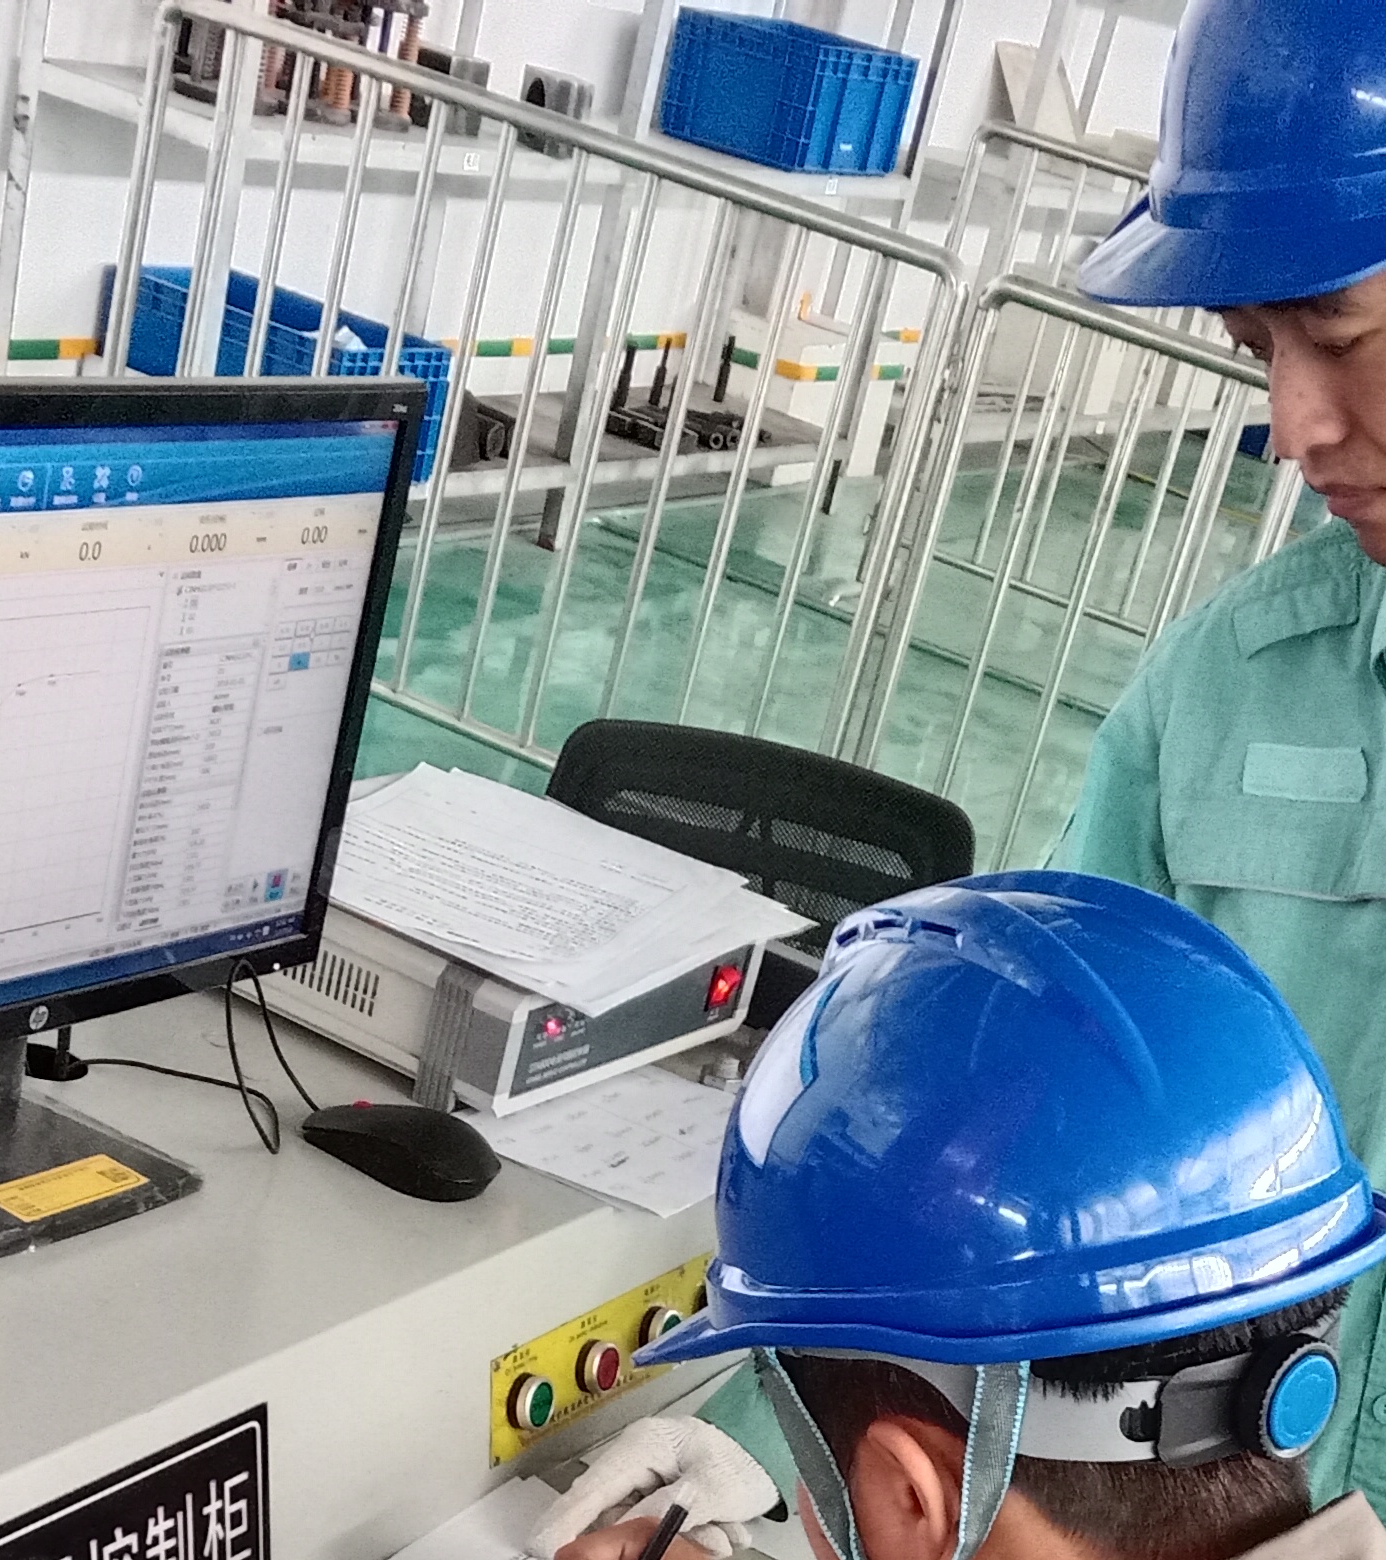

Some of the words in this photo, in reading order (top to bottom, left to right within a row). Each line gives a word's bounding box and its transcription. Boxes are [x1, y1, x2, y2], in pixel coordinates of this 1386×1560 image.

[189, 533, 227, 553] 0.000
[300, 525, 329, 545] 0.00
[78, 541, 102, 562] 0.0
